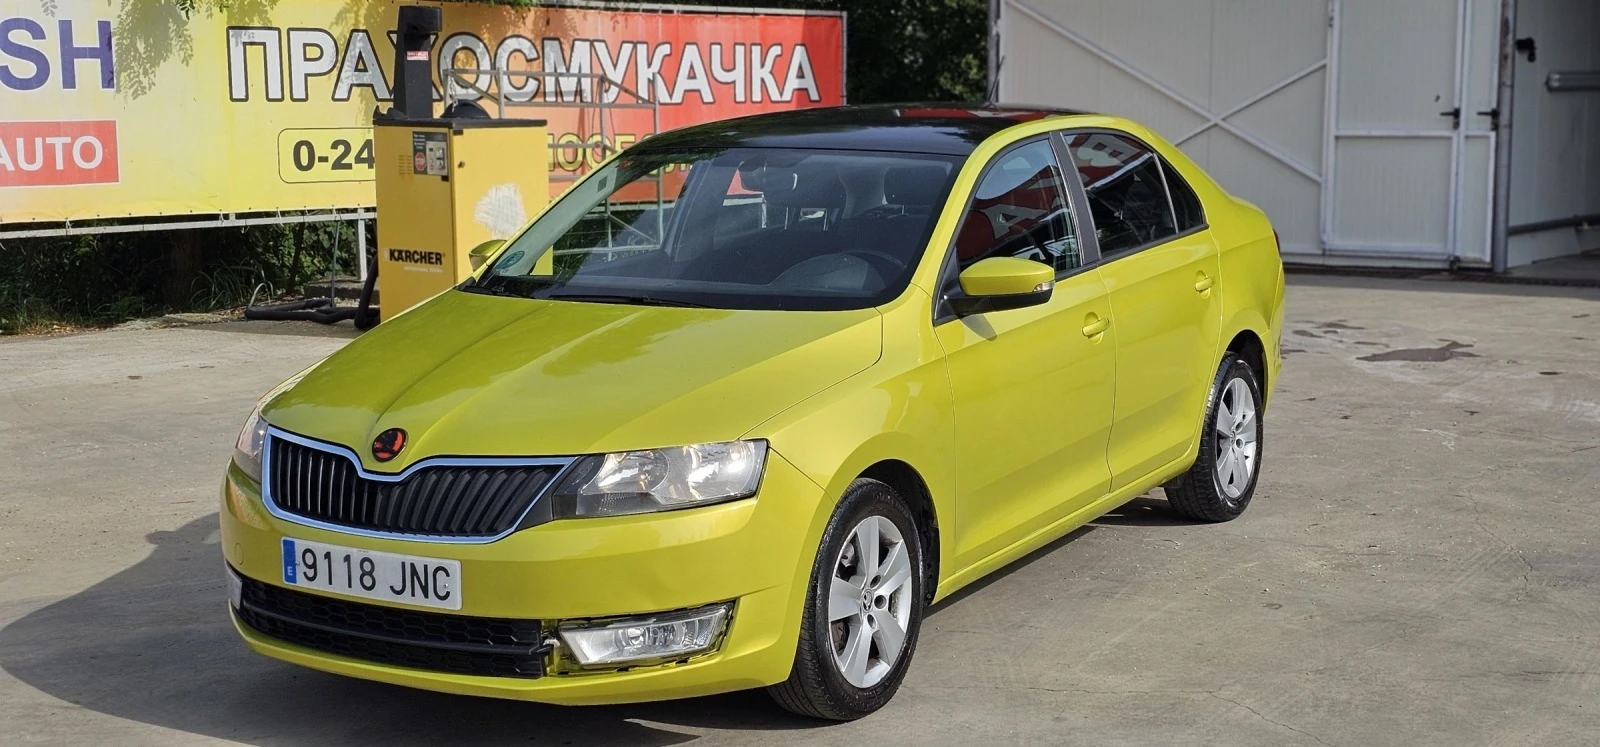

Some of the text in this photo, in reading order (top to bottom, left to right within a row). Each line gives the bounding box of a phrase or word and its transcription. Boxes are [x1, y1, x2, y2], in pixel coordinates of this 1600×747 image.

[0, 17, 116, 91] SH
[293, 139, 375, 172] 0-24
[287, 566, 293, 576] E
[302, 547, 451, 601] 9118 JNC
